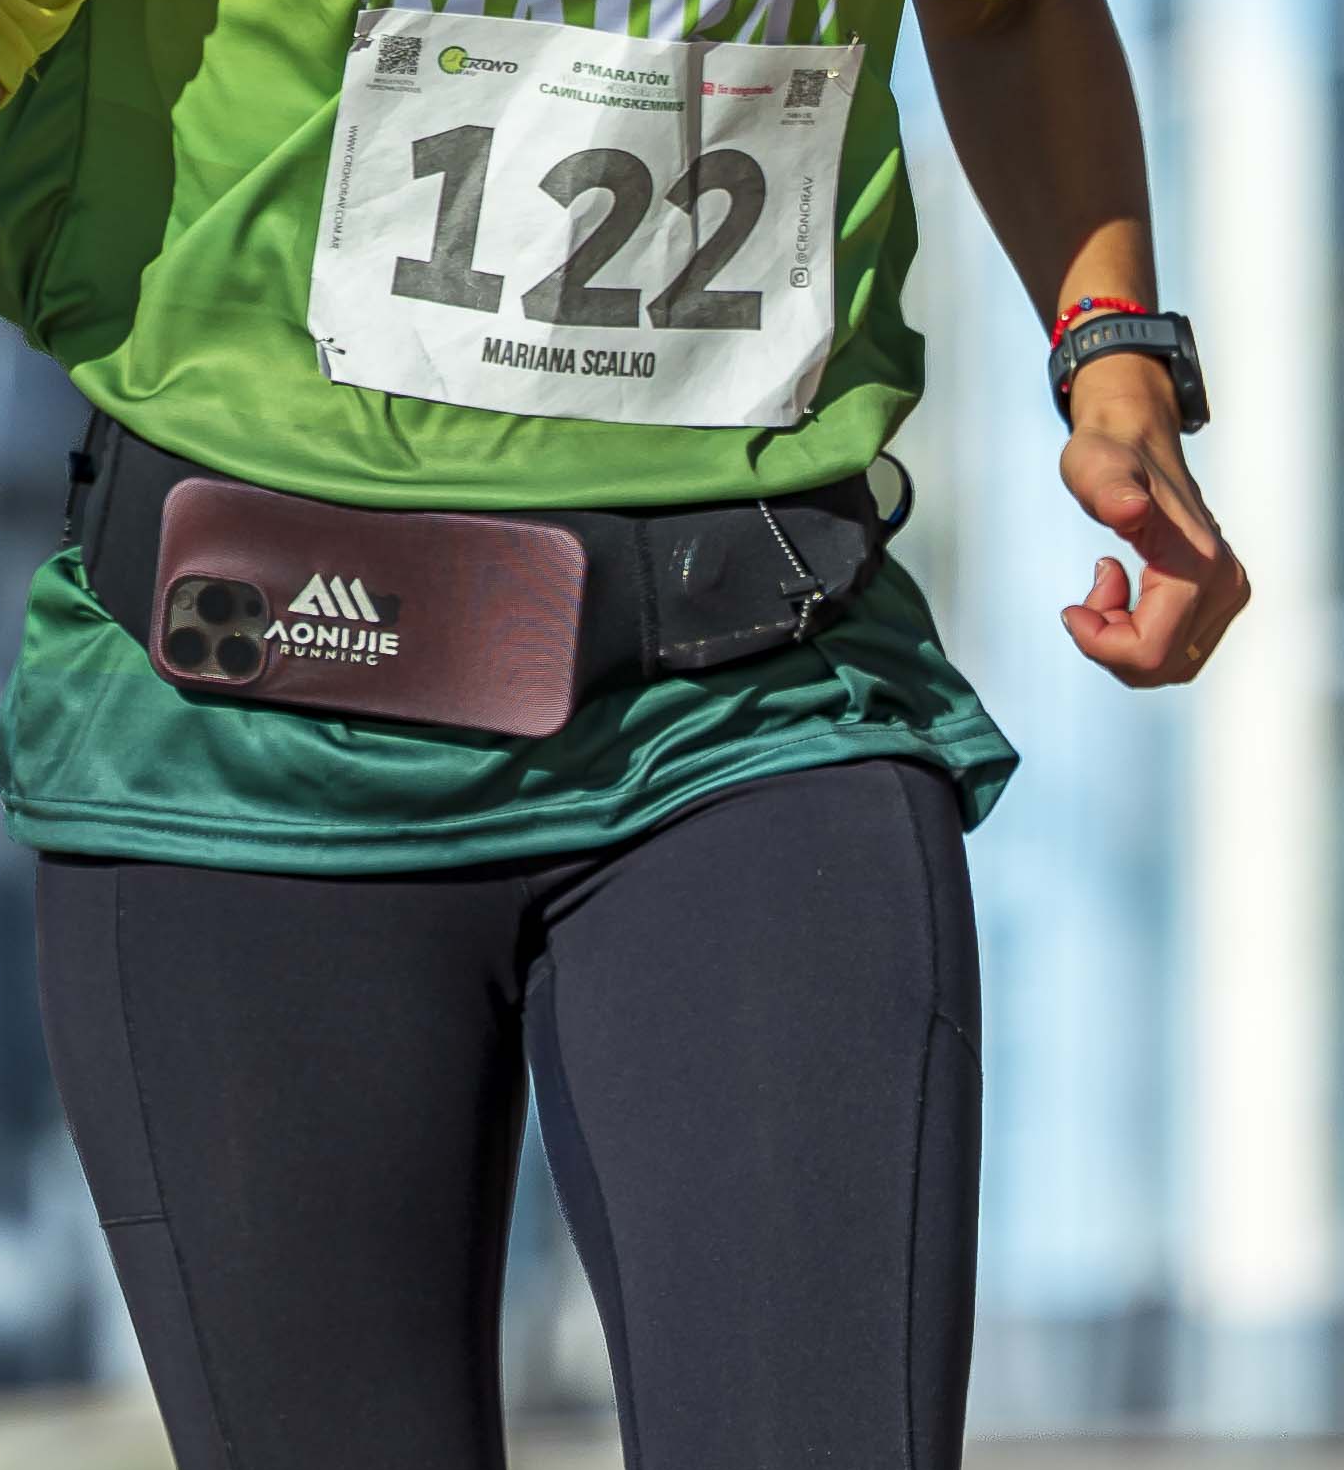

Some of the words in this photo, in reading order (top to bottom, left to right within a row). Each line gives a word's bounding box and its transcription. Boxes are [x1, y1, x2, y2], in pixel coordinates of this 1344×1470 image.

[391, 124, 767, 331] 122
[482, 337, 576, 374] MARIANA
[581, 350, 656, 379] SCALKO
[263, 619, 400, 656] AONIJIE
[279, 643, 379, 666] RUNNING
